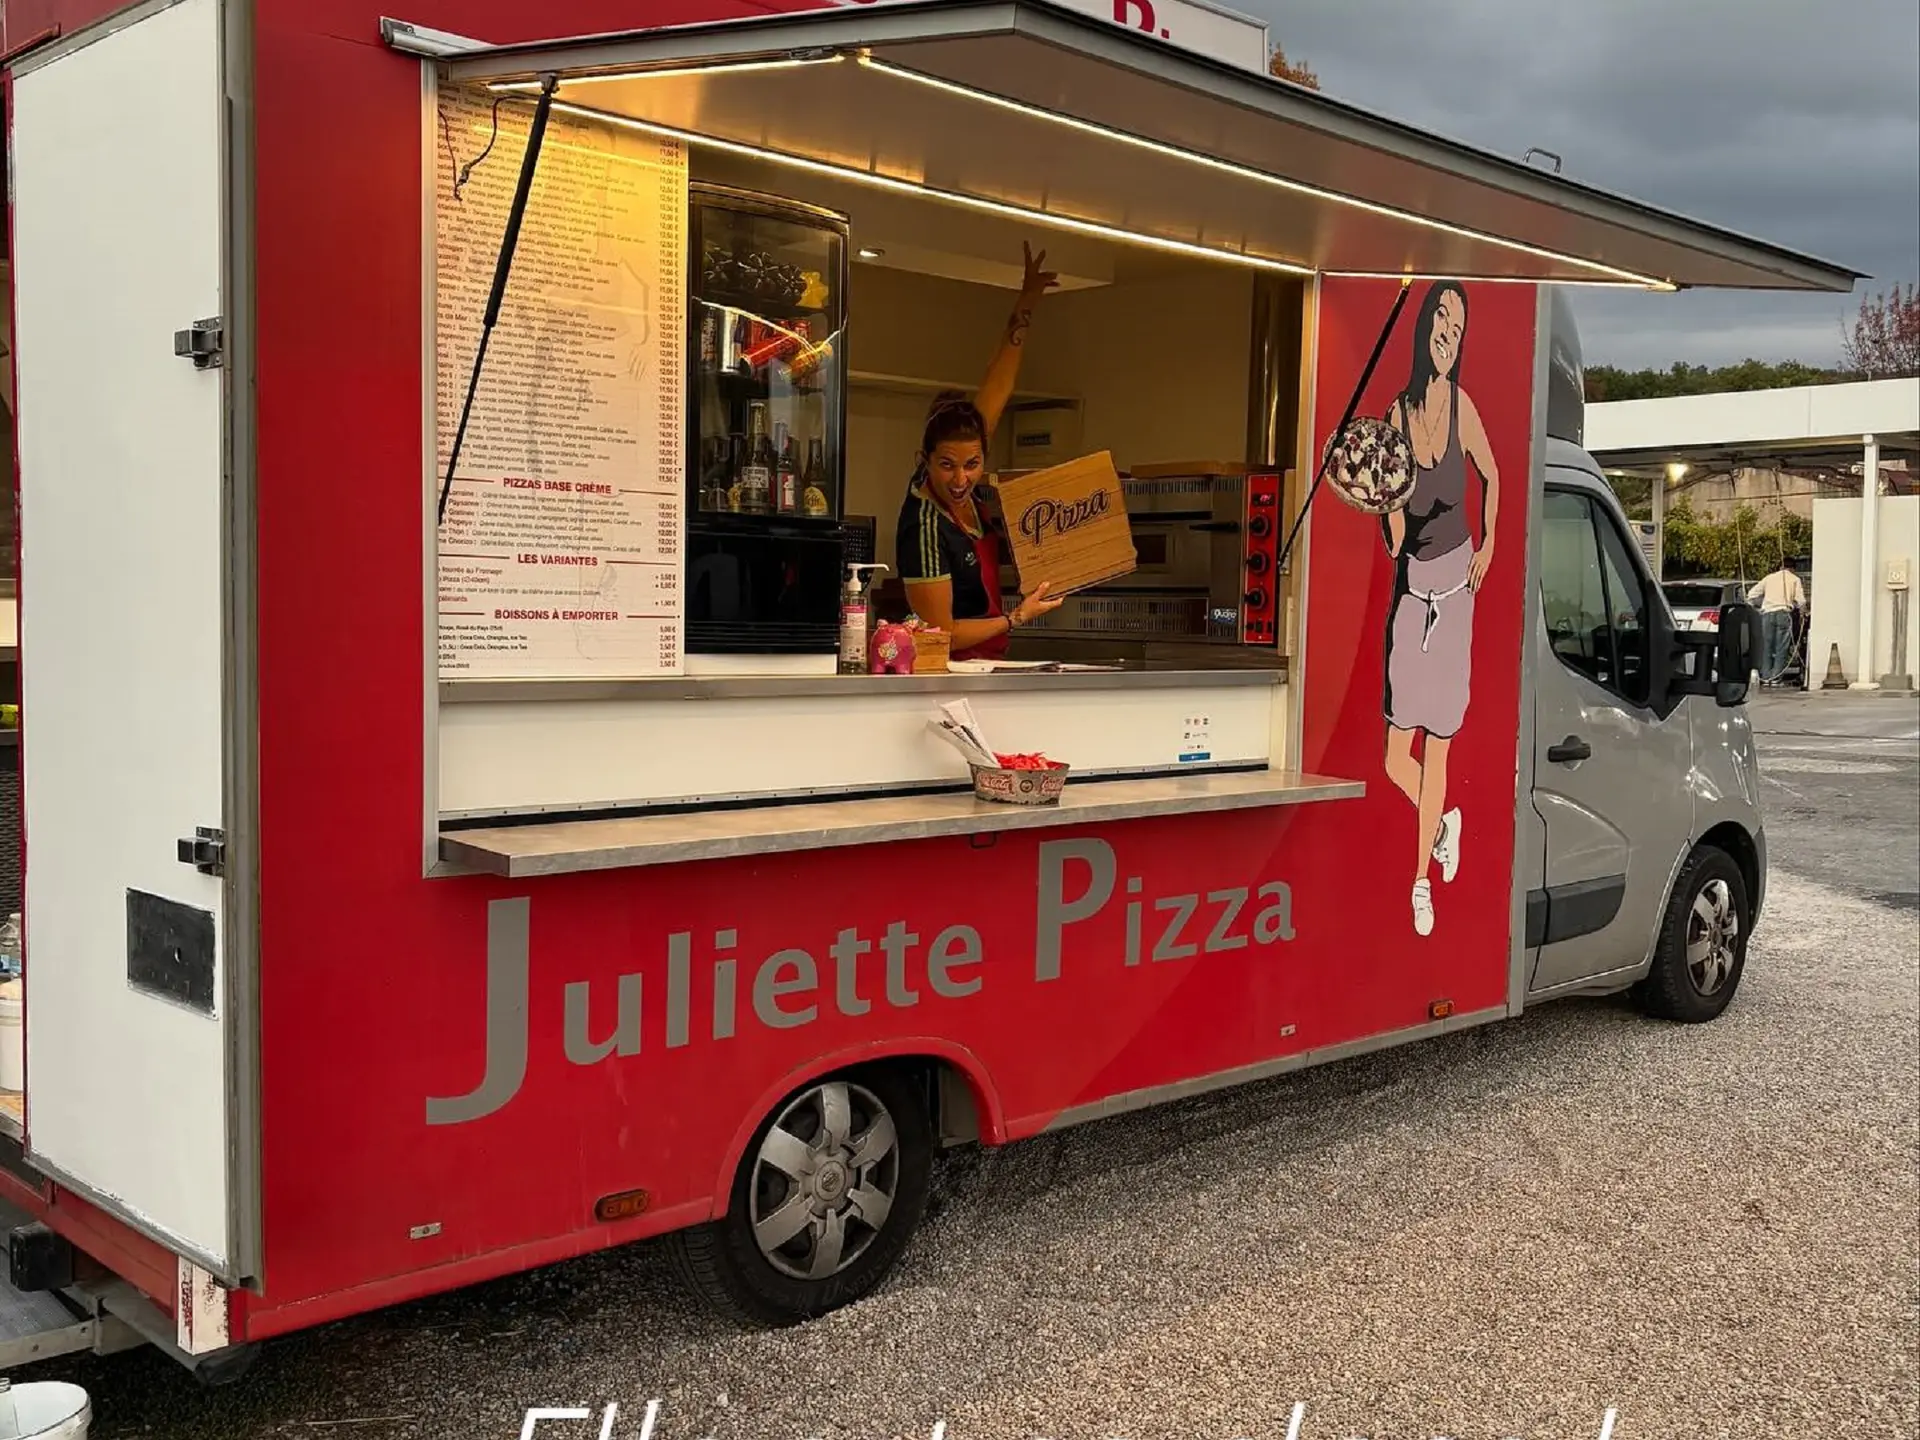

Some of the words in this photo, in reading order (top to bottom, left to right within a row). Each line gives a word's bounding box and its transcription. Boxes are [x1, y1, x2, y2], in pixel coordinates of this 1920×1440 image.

[503, 478, 542, 491] PIZZAS
[544, 481, 571, 492] BASE
[575, 482, 612, 494] CRÈME
[1020, 487, 1111, 547] Pizza
[517, 553, 538, 565] LES
[540, 554, 598, 566] VARIANTES
[495, 609, 549, 621] BOISSONS
[552, 608, 560, 621] À
[562, 609, 618, 622] EMPORTER
[426, 896, 983, 1126] Juliette
[1035, 839, 1298, 983] Pizza
